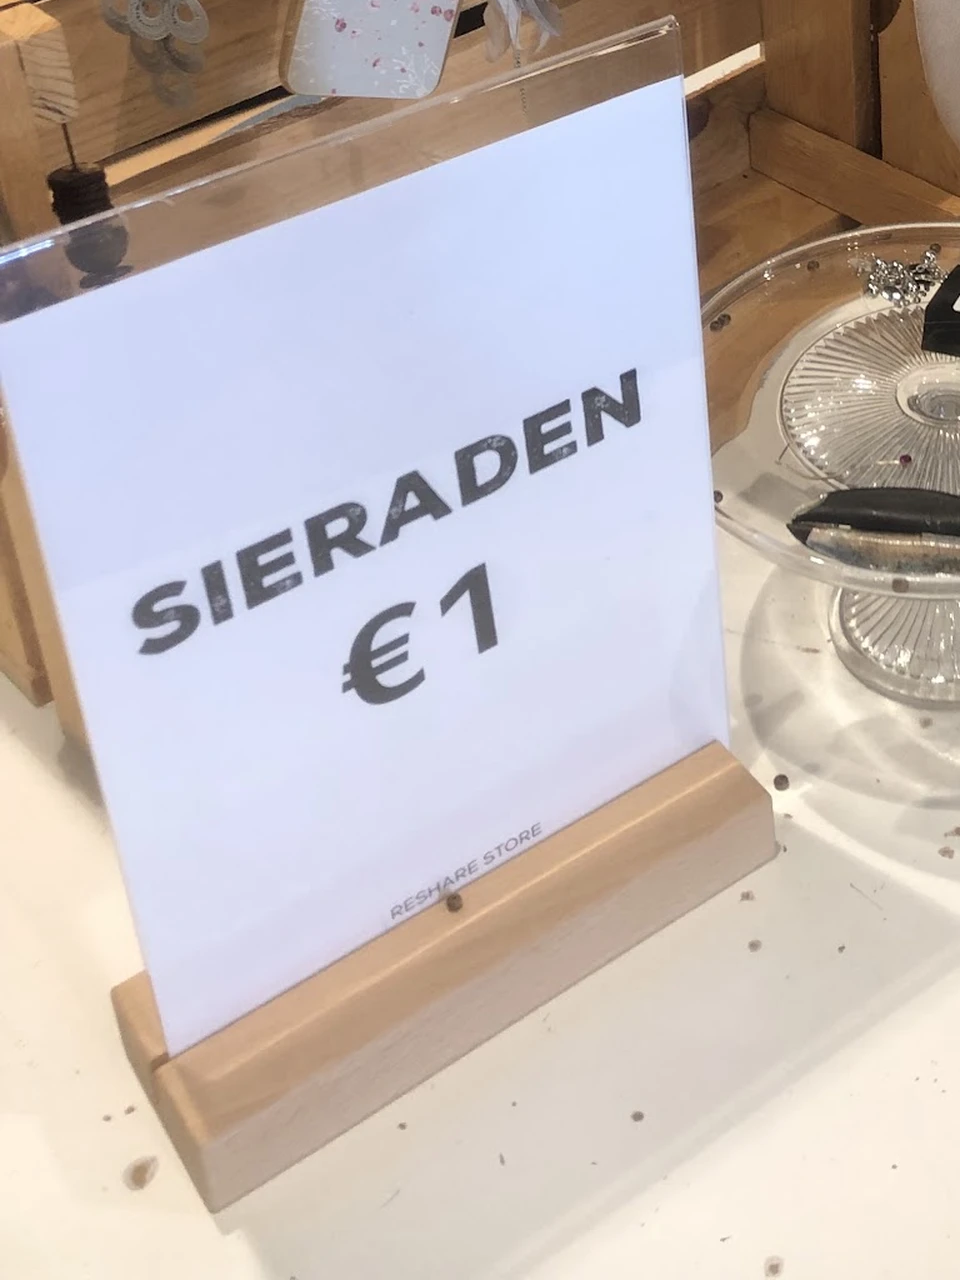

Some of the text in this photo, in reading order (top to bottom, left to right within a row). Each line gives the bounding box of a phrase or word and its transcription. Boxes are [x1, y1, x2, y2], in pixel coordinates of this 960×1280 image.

[131, 368, 642, 656] SIERADEN
[389, 821, 543, 920] RESHARE STORE
